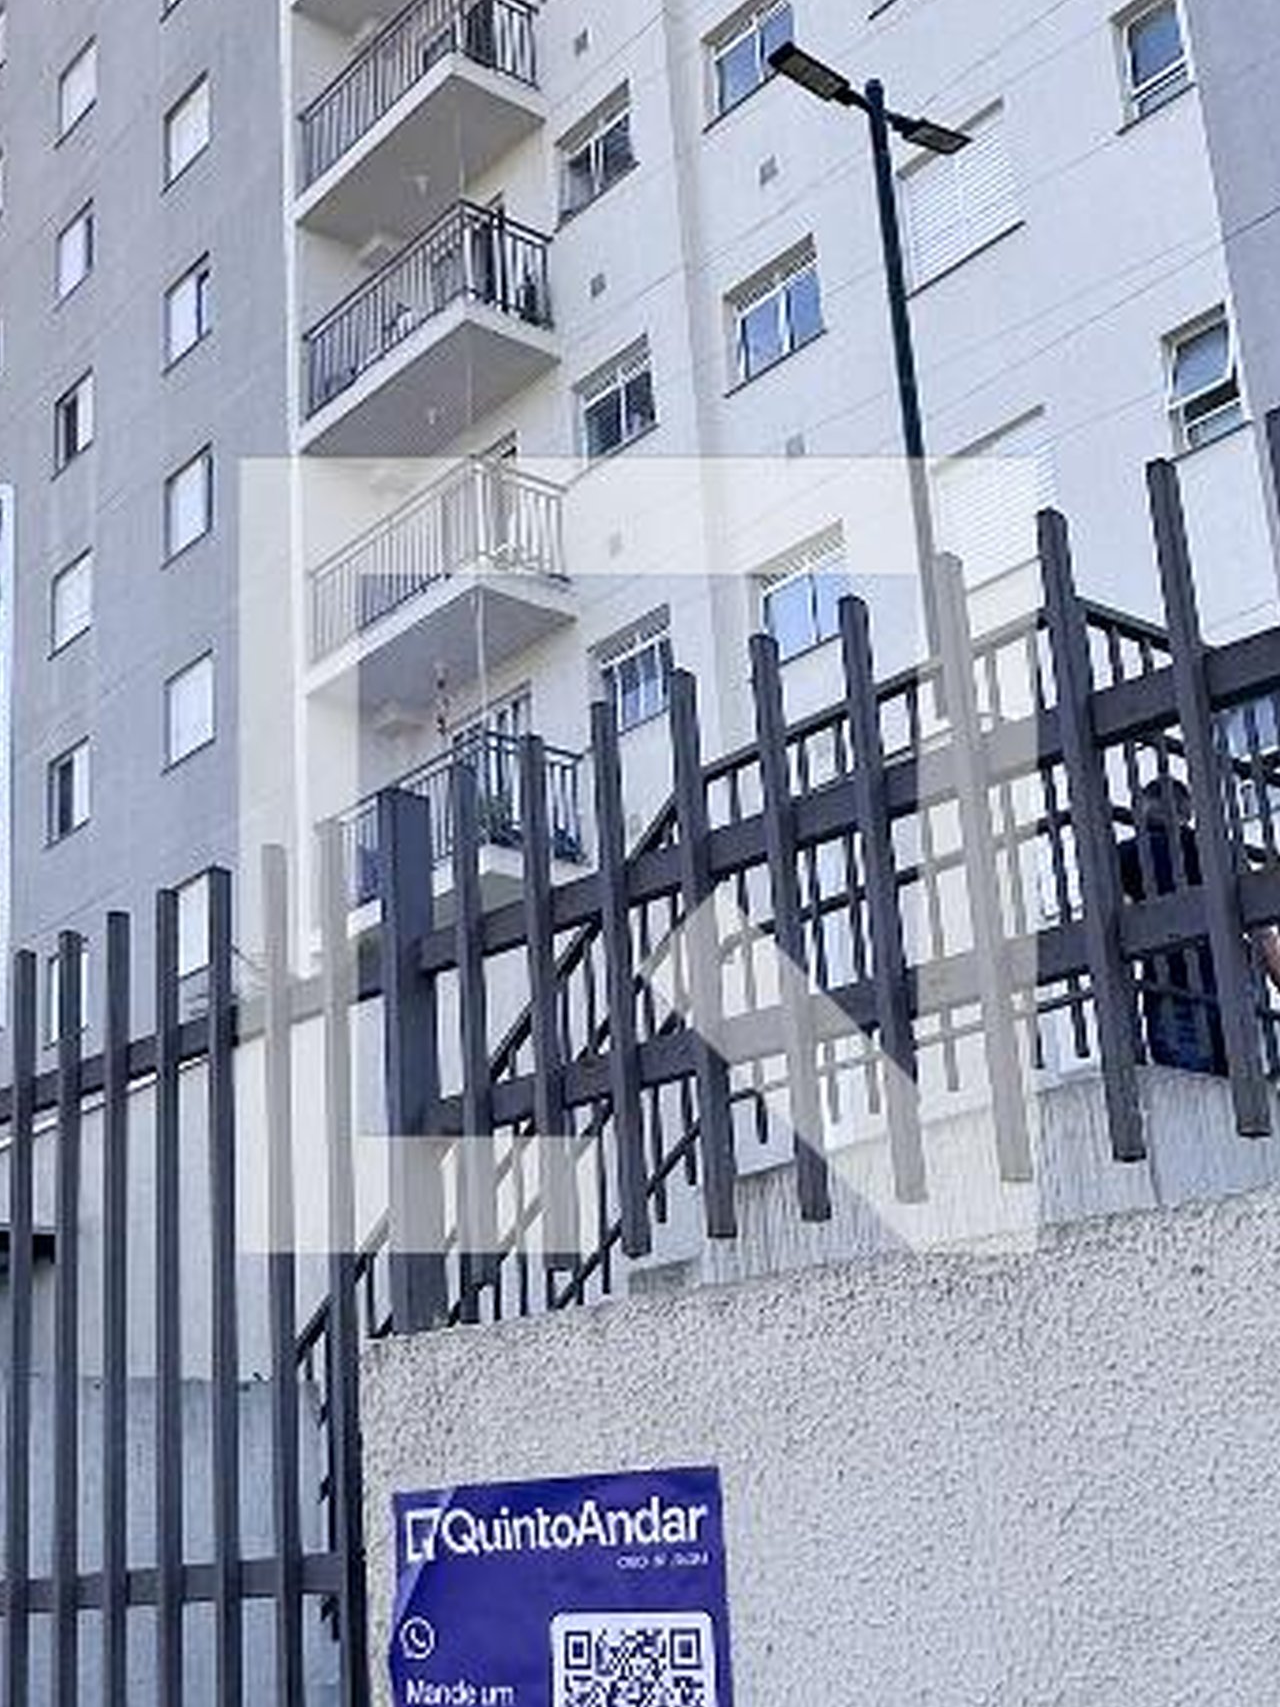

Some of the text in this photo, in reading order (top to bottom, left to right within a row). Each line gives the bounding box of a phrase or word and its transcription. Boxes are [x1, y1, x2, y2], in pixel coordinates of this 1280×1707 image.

[441, 1496, 708, 1556] QuintoAndar
[406, 1678, 514, 1706] Mande um
